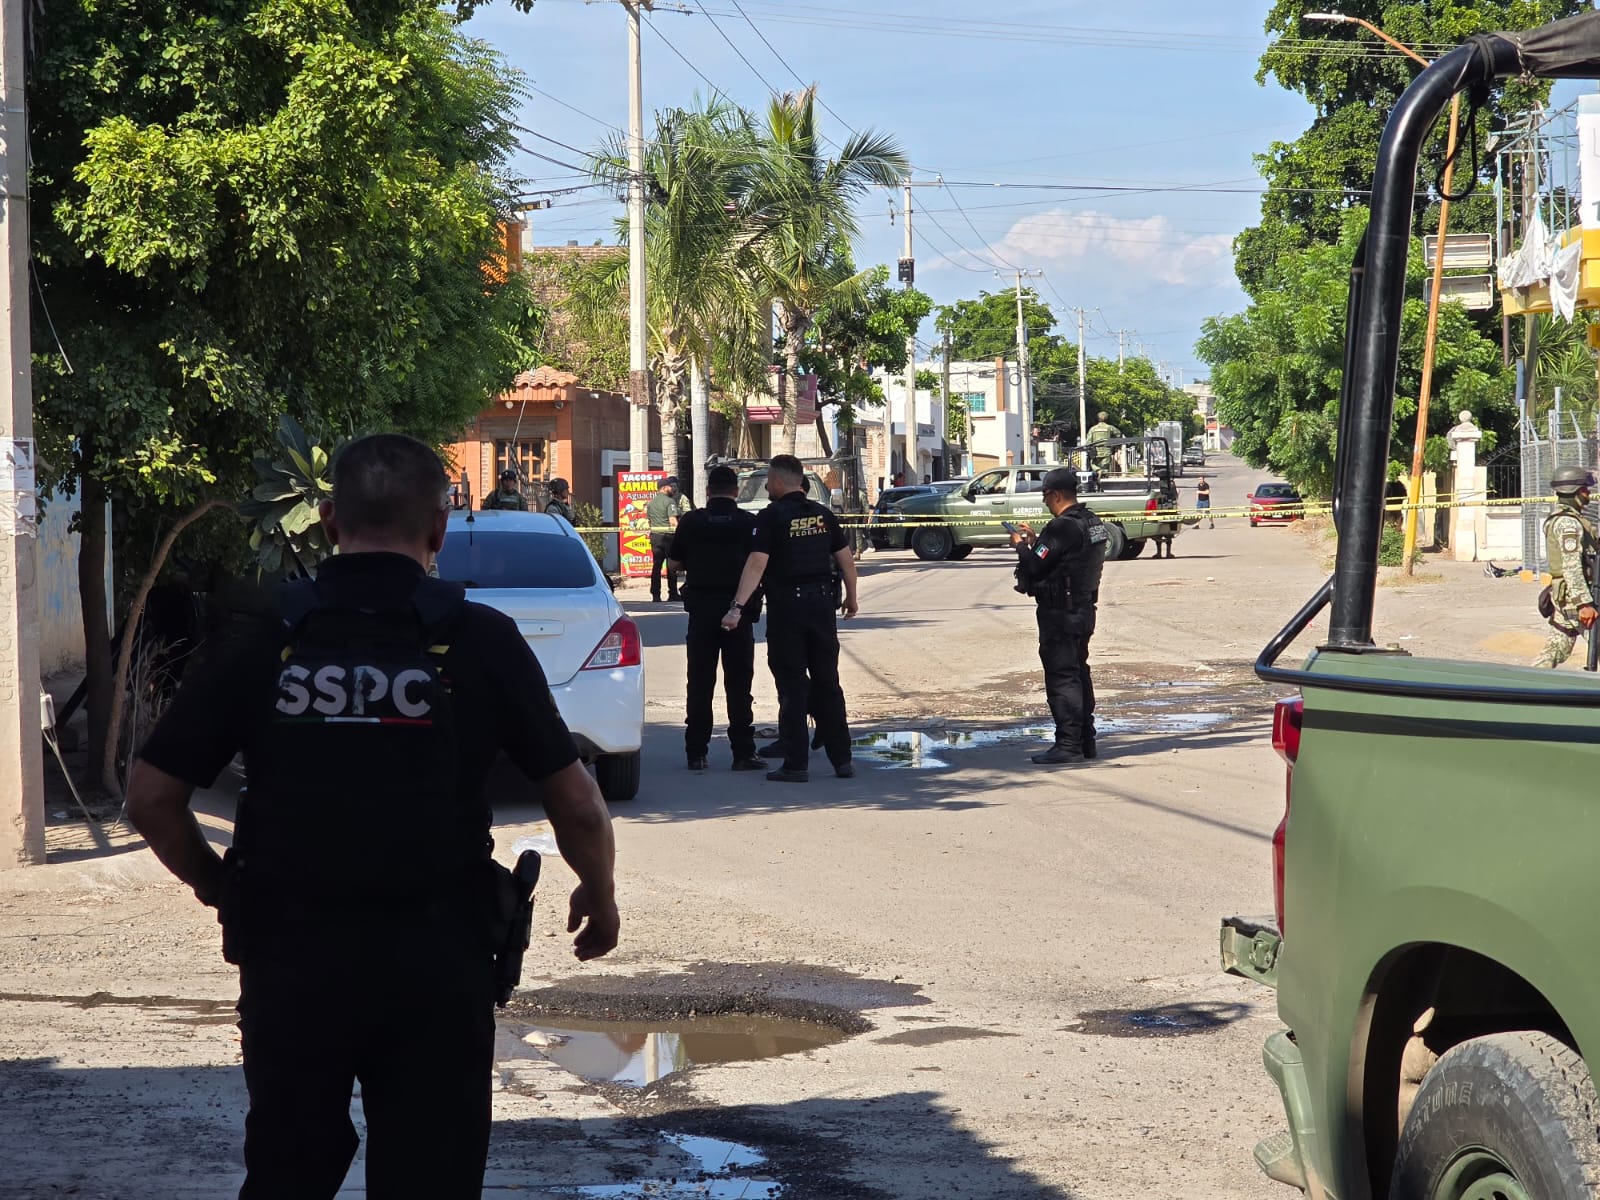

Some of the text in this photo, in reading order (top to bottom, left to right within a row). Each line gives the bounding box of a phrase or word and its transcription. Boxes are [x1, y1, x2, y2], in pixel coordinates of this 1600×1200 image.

[622, 474, 653, 482] TACOS
[619, 481, 658, 492] CAMAR
[790, 515, 824, 530] SSPC
[790, 528, 828, 538] FEDERAL
[275, 664, 432, 718] SSPC
